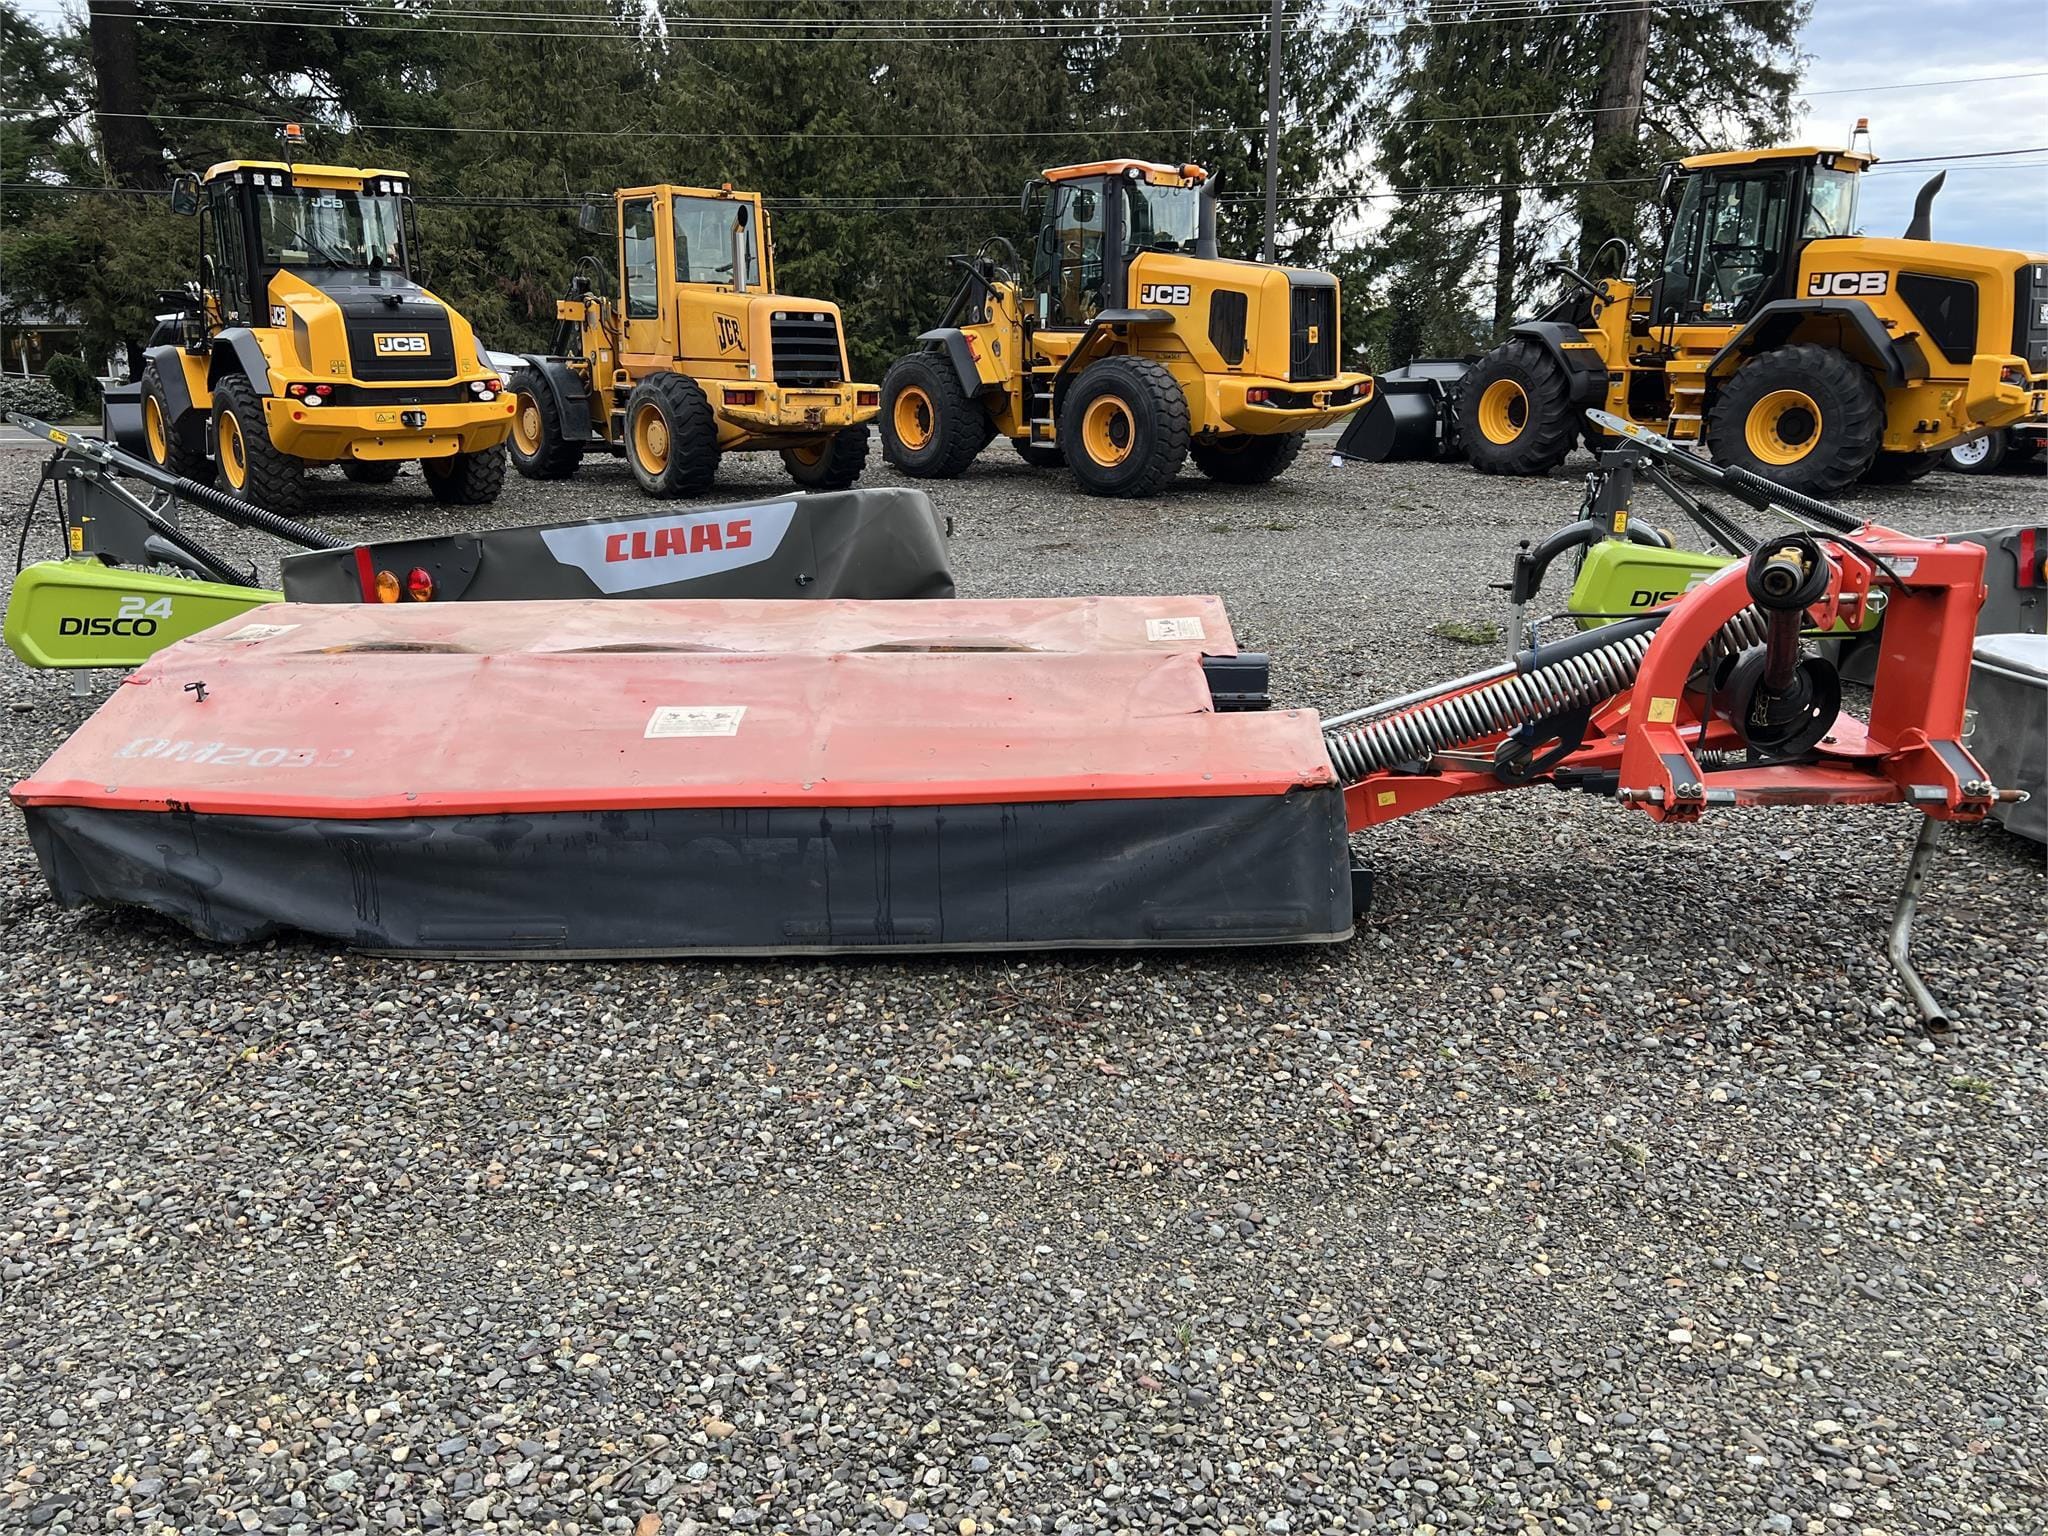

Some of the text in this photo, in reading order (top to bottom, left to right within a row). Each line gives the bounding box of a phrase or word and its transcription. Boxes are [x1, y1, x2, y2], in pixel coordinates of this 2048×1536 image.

[311, 197, 344, 208] JCB
[1809, 272, 1888, 295] JCB
[1142, 285, 1190, 304] JCB
[271, 306, 287, 325] JCB
[717, 316, 746, 352] JCB
[378, 337, 426, 352] JCB
[605, 519, 752, 563] CLAAS
[118, 596, 173, 619] 24
[58, 617, 158, 637] DISCO
